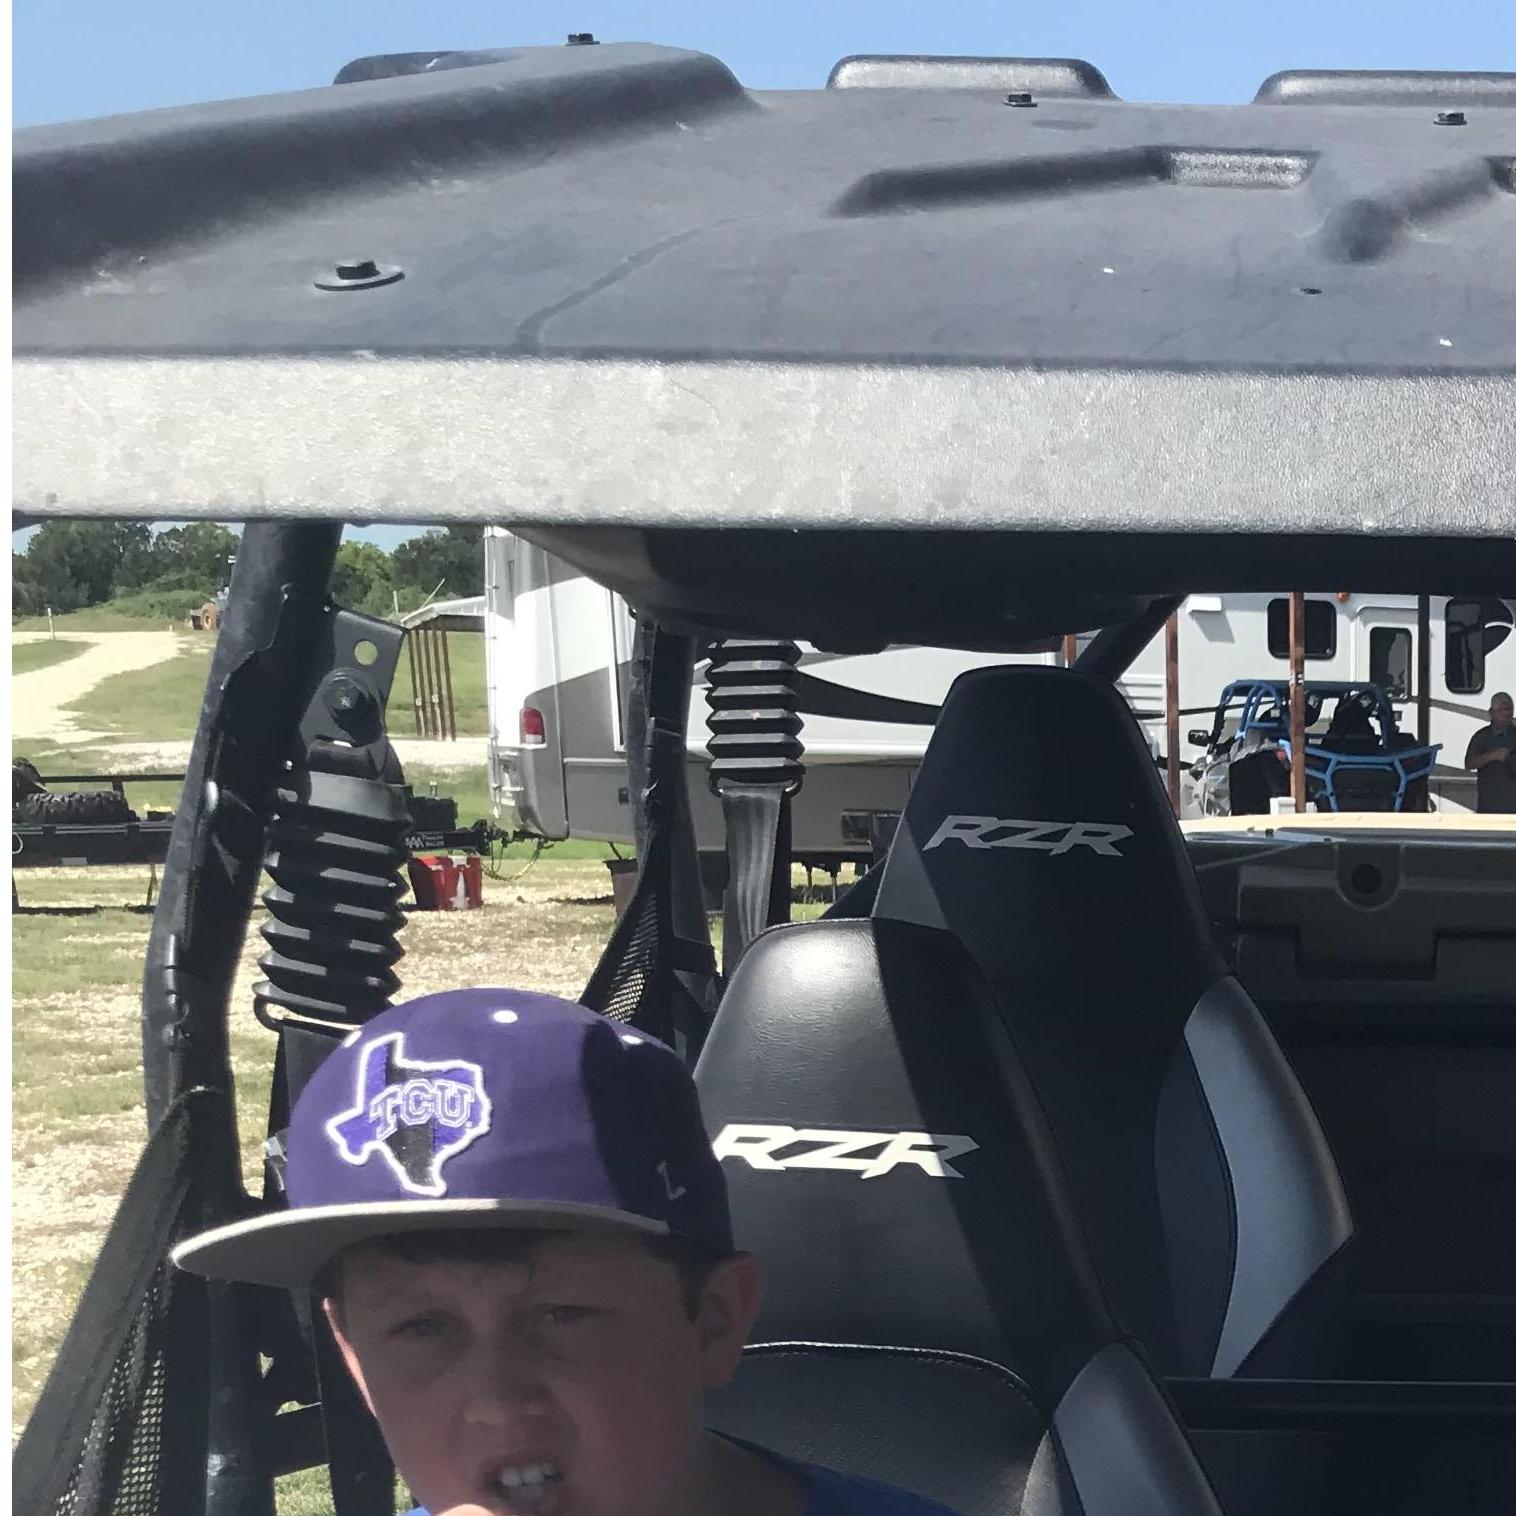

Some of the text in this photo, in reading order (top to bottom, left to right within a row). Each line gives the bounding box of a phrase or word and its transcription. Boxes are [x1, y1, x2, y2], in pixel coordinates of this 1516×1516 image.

[922, 814, 1134, 857] RZR
[369, 1079, 475, 1141] TCU
[712, 1123, 980, 1179] RZR
